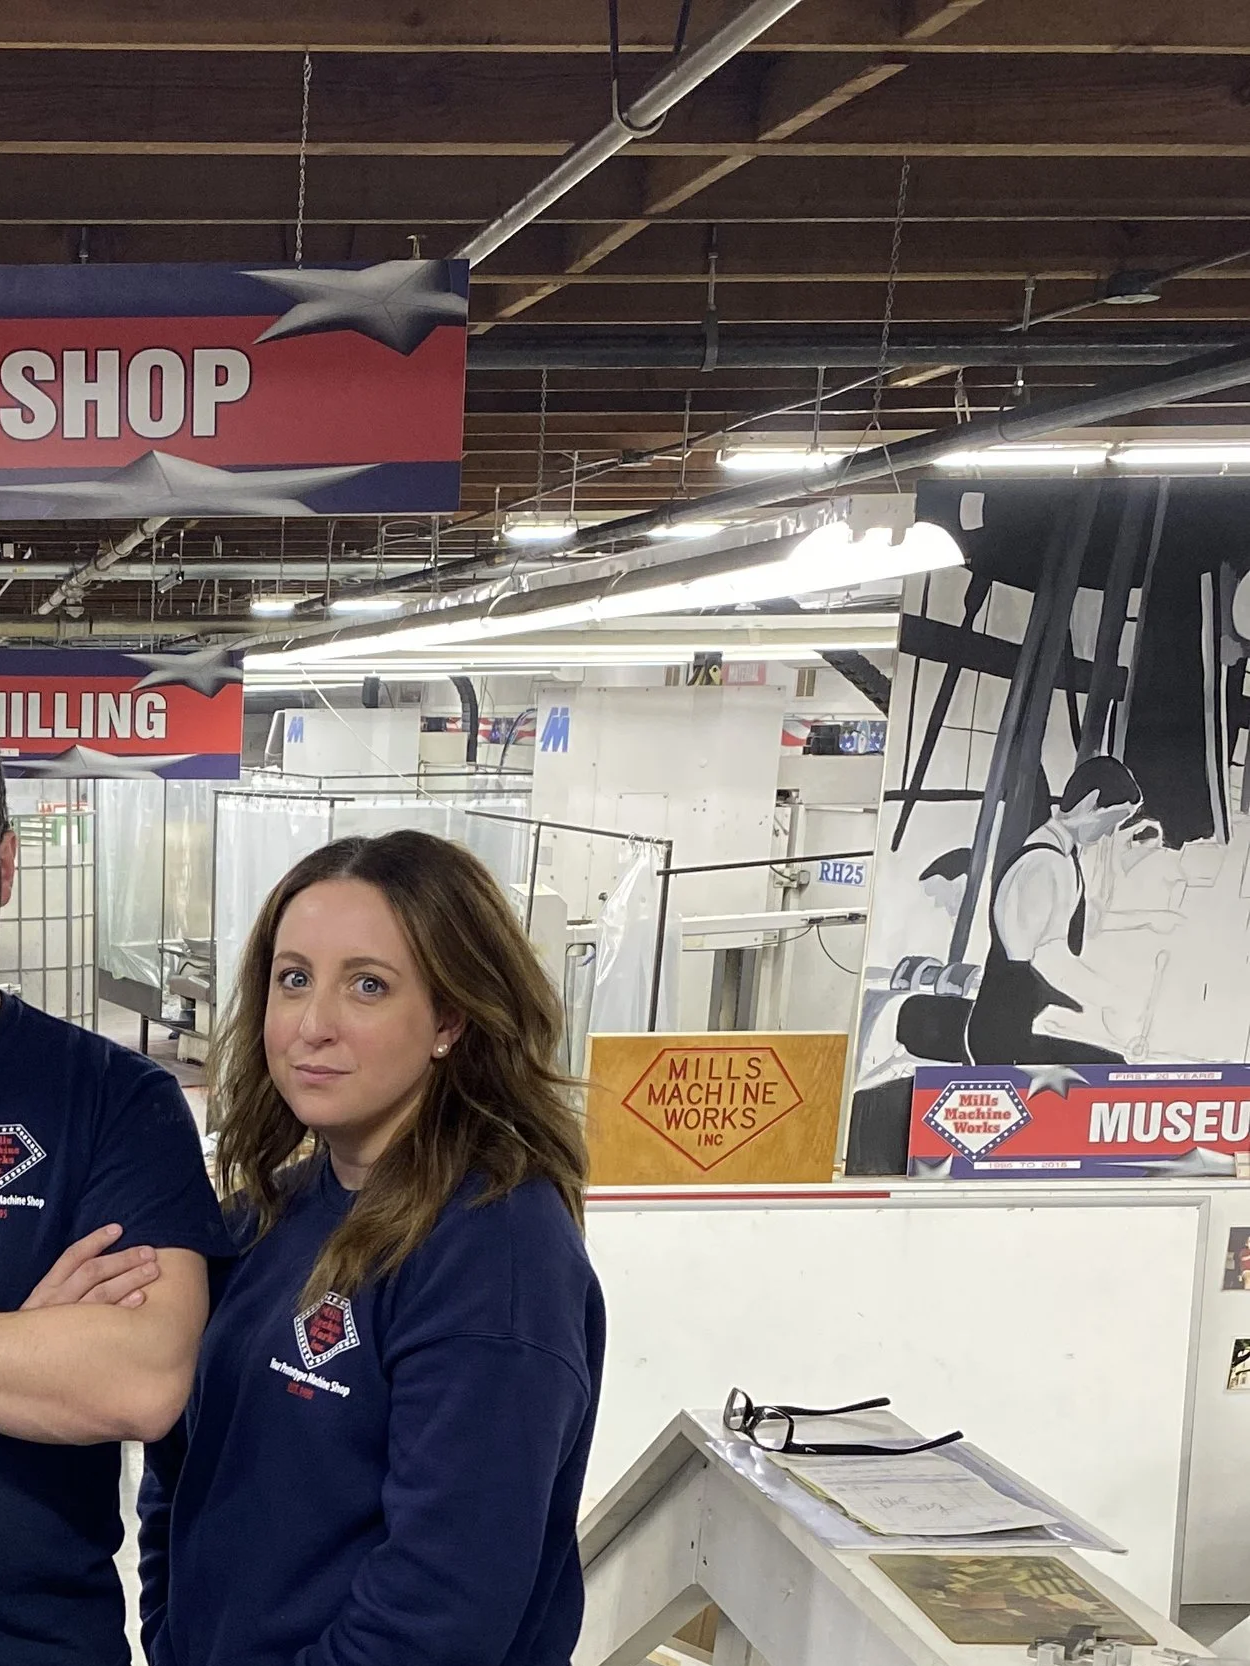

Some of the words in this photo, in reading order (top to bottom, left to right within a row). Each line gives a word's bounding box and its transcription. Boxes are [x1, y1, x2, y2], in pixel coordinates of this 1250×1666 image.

[819, 861, 864, 885] RH25
[669, 1057, 762, 1081] MILLS
[648, 1082, 778, 1105] MACHINE
[959, 1094, 998, 1106] Mills
[664, 1107, 756, 1130] WORKS
[943, 1107, 1011, 1120] Machine
[953, 1121, 1000, 1134] Works
[697, 1133, 724, 1146] INC
[27, 1195, 45, 1209] Shop
